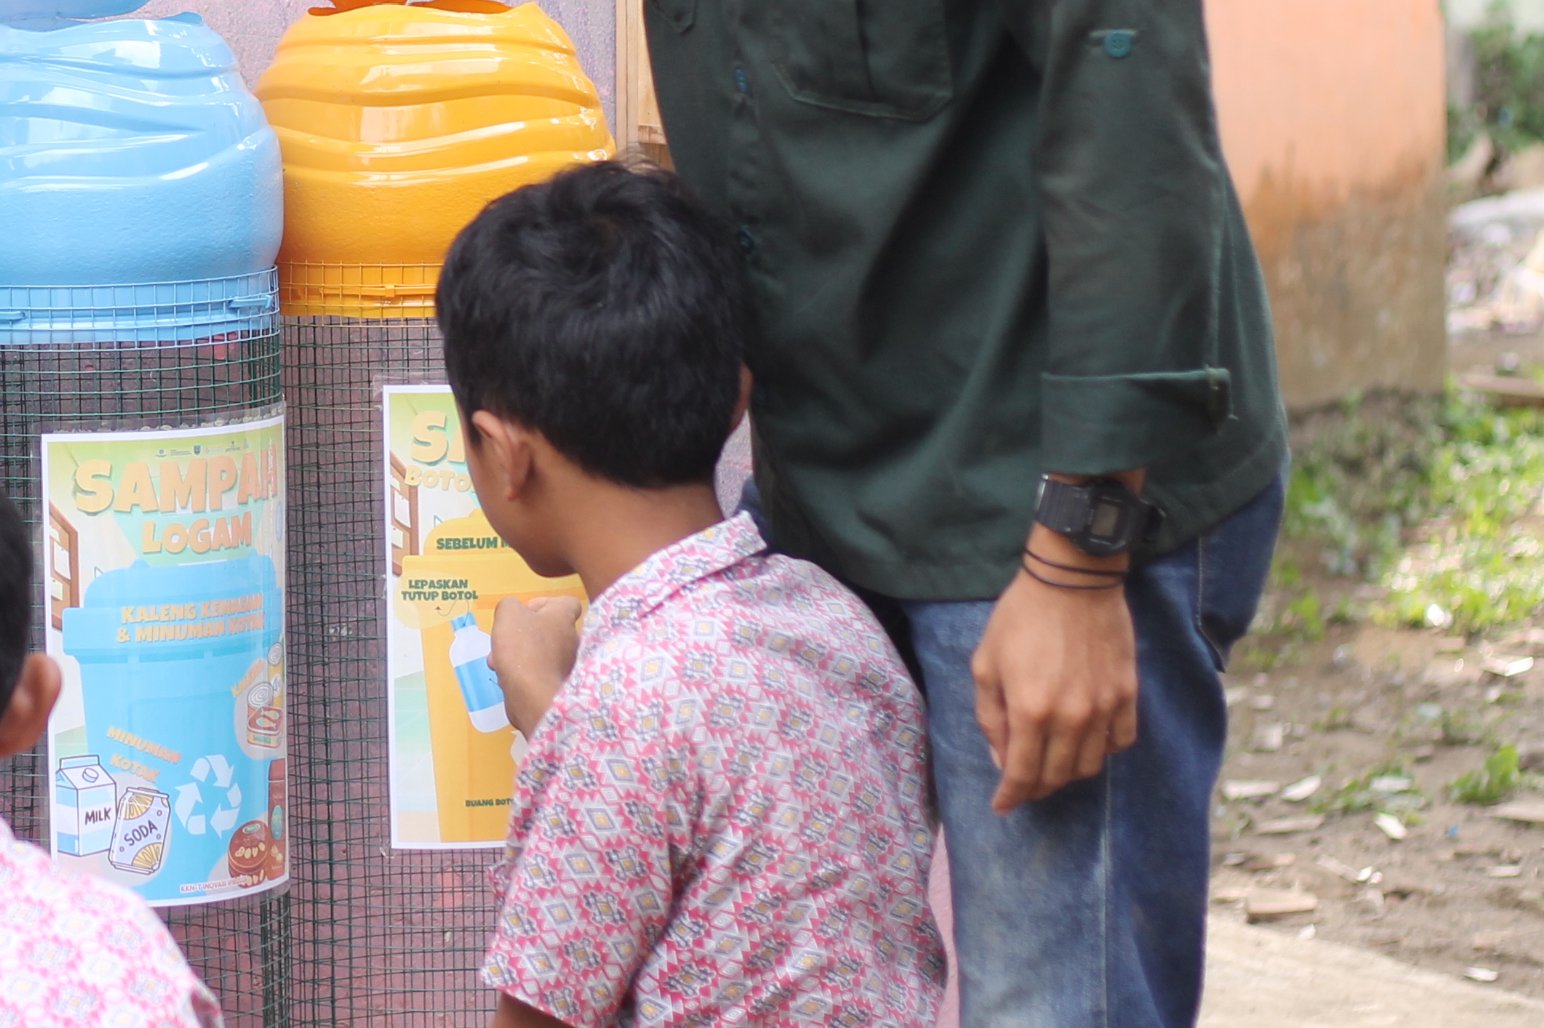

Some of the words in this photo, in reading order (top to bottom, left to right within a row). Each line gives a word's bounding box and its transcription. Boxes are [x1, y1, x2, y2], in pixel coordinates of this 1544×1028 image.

[74, 443, 279, 514] SAMPAH
[142, 511, 252, 554] LOGAM
[436, 536, 498, 550] SEBELUM
[401, 590, 440, 601] TUTUP
[441, 590, 479, 601] BOTOL
[408, 579, 469, 590] LEPASKAN
[121, 602, 198, 624] KALENG
[200, 592, 264, 619] KEMASAN
[116, 626, 132, 643] &
[135, 619, 226, 643] MINUMAN
[106, 725, 182, 765] MINUMAN
[109, 753, 162, 783] KOTAK
[84, 806, 112, 825] MILK
[123, 819, 159, 847] SODA
